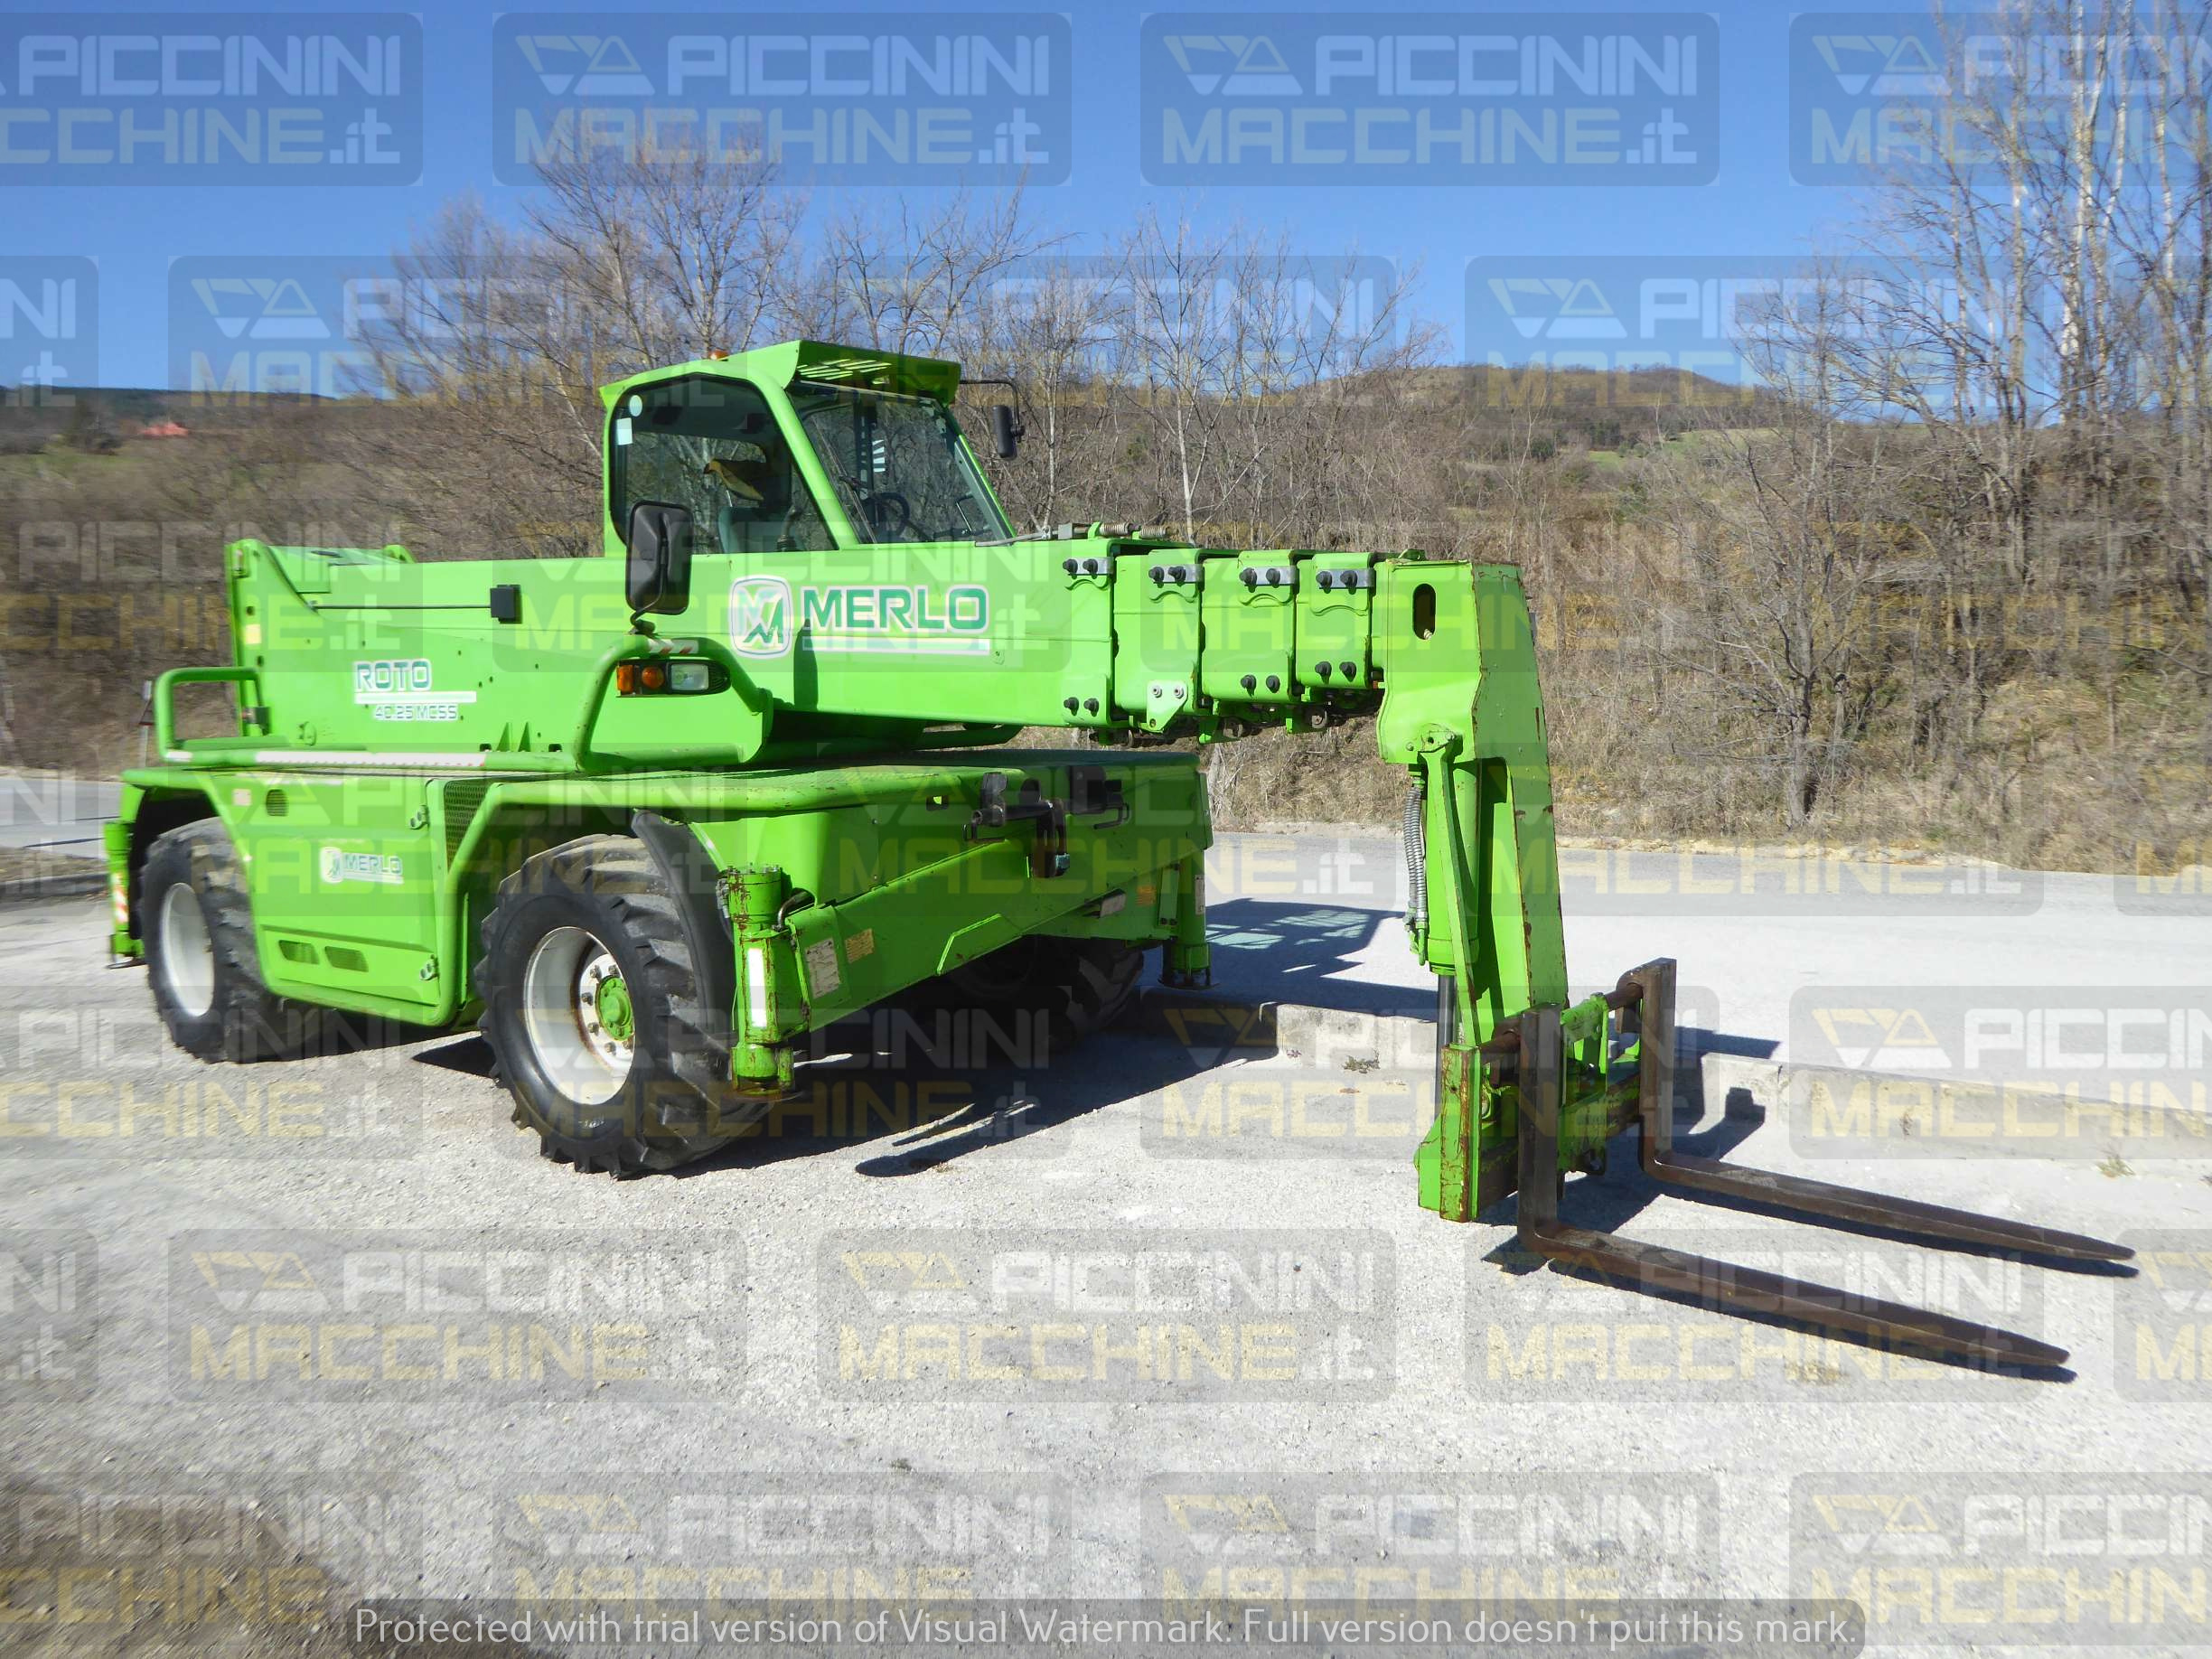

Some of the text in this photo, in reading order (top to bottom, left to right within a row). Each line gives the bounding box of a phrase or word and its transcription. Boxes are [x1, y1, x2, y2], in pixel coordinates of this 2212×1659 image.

[802, 587, 987, 630] MERLO
[356, 660, 431, 689] ROTO
[417, 705, 457, 719] MCSS
[344, 853, 403, 875] MERLO
